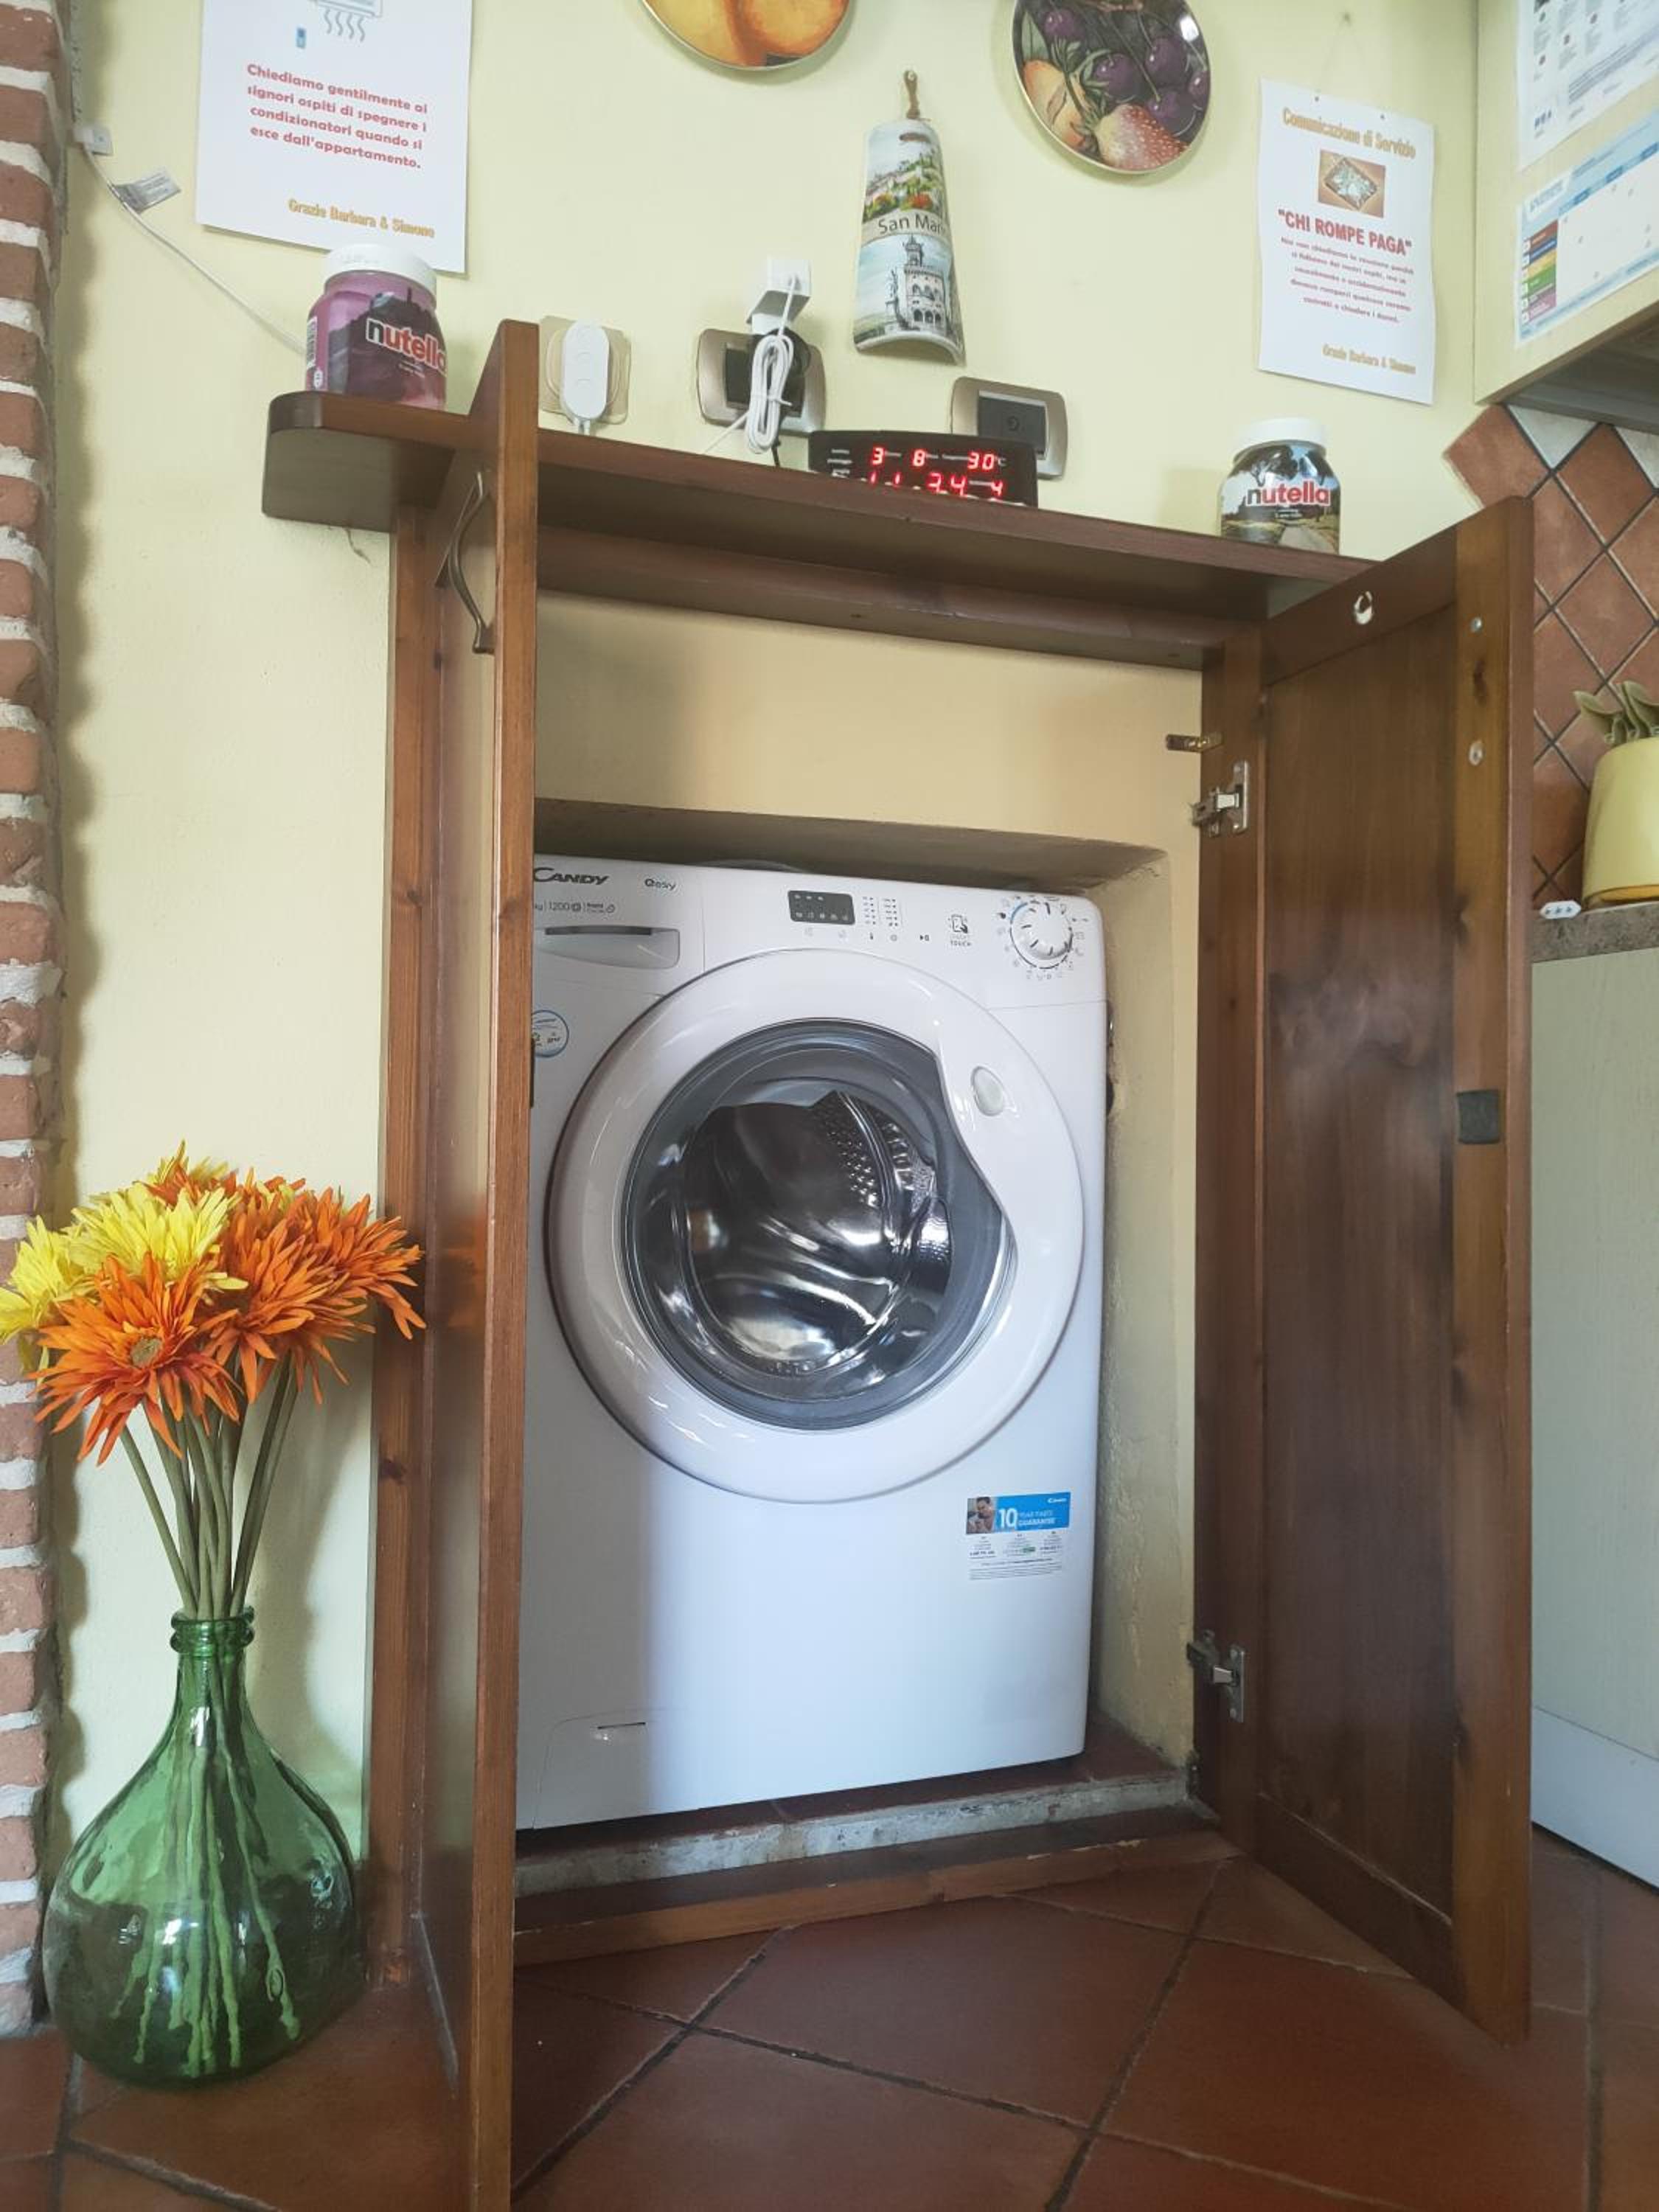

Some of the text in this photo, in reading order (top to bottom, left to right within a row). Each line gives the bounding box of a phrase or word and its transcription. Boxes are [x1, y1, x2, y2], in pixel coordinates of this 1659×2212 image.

[247, 64, 428, 114] Chiediamo gentilmente ai
[248, 85, 294, 108] signori
[298, 95, 336, 114] ospiti
[340, 102, 354, 117] di
[357, 109, 418, 132] spegnere
[250, 106, 422, 150] condizionatori quando si
[250, 126, 422, 169] esce dall'appartamento.
[288, 198, 435, 238] Grazie Barbara & Simone
[878, 216, 910, 234] San
[1278, 209, 1412, 257] "CHI ROMPE PAGA"
[872, 447, 885, 465] 3
[913, 448, 927, 467] 8
[1246, 479, 1331, 507] nutella
[998, 1507, 1018, 1529] 10
